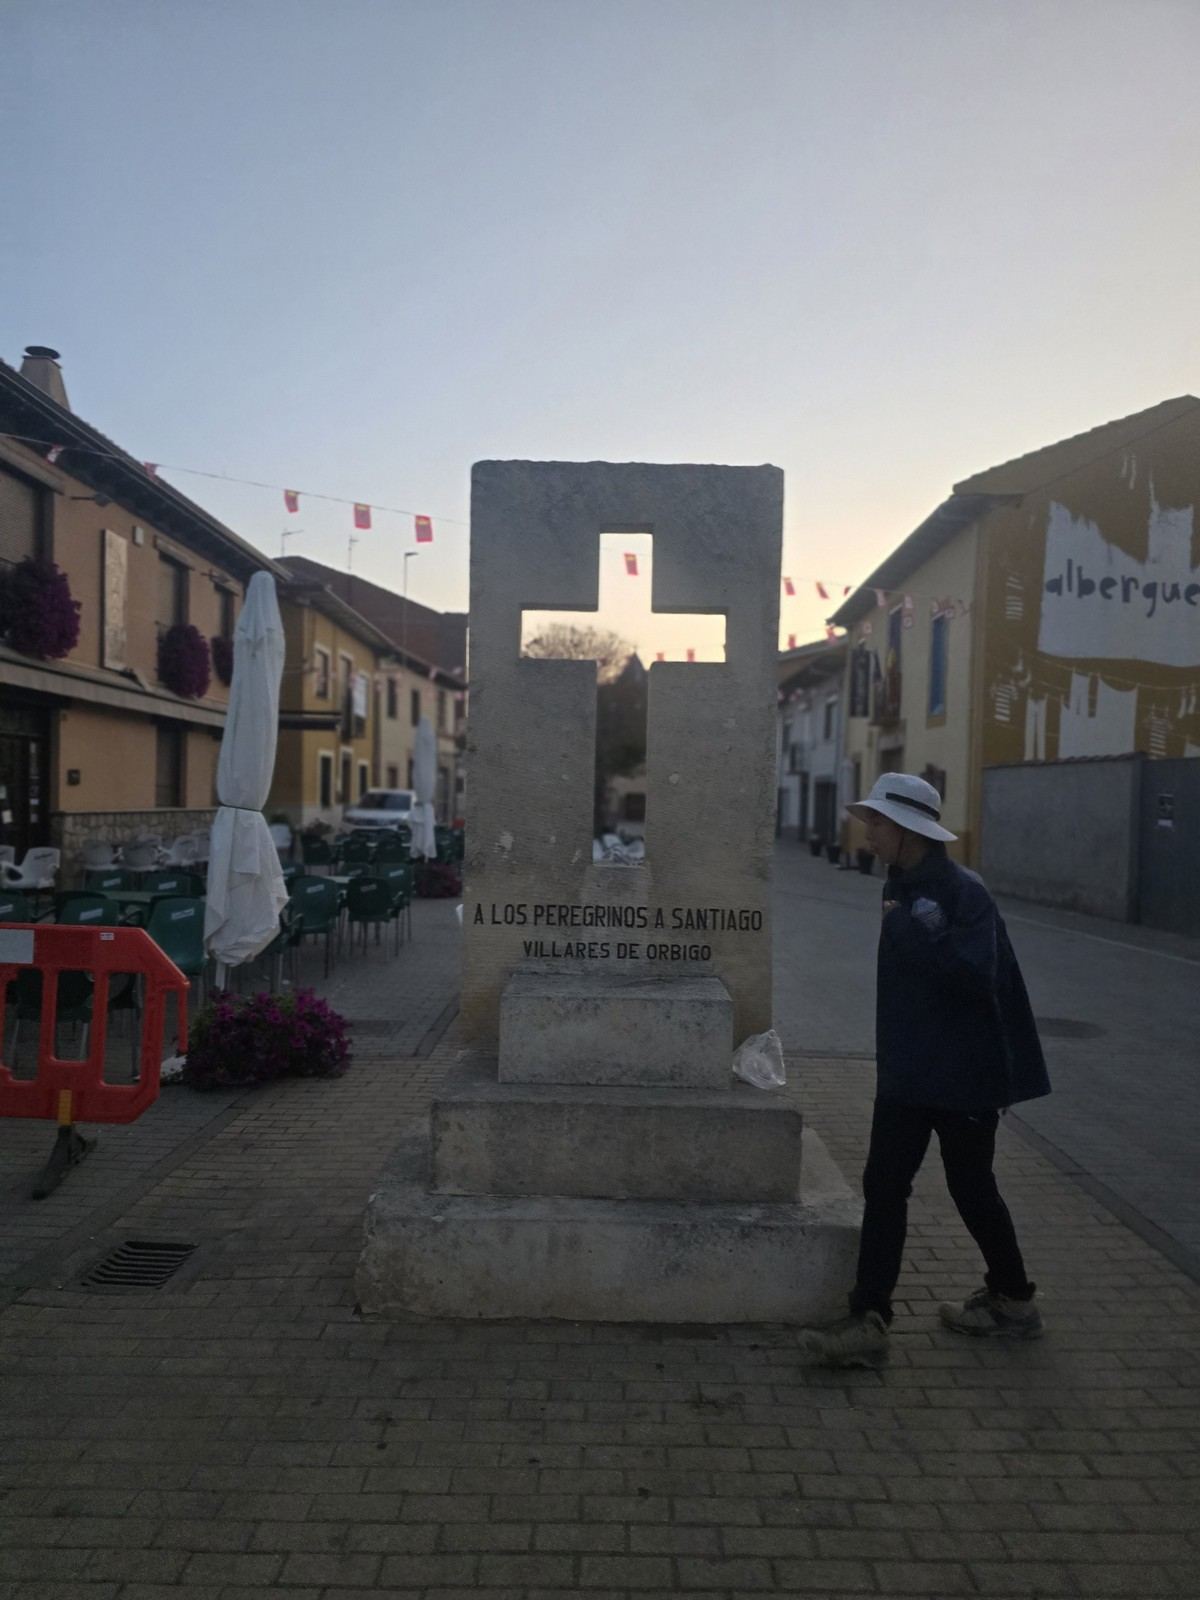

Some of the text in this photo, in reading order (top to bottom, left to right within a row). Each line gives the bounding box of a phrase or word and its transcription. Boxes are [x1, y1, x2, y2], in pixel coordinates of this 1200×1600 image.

[1045, 558, 1200, 618] albergue
[473, 903, 762, 931] A LOS PEREGRINOS A SANTIAGO
[523, 940, 711, 961] VILLARES DE ORBIGO
